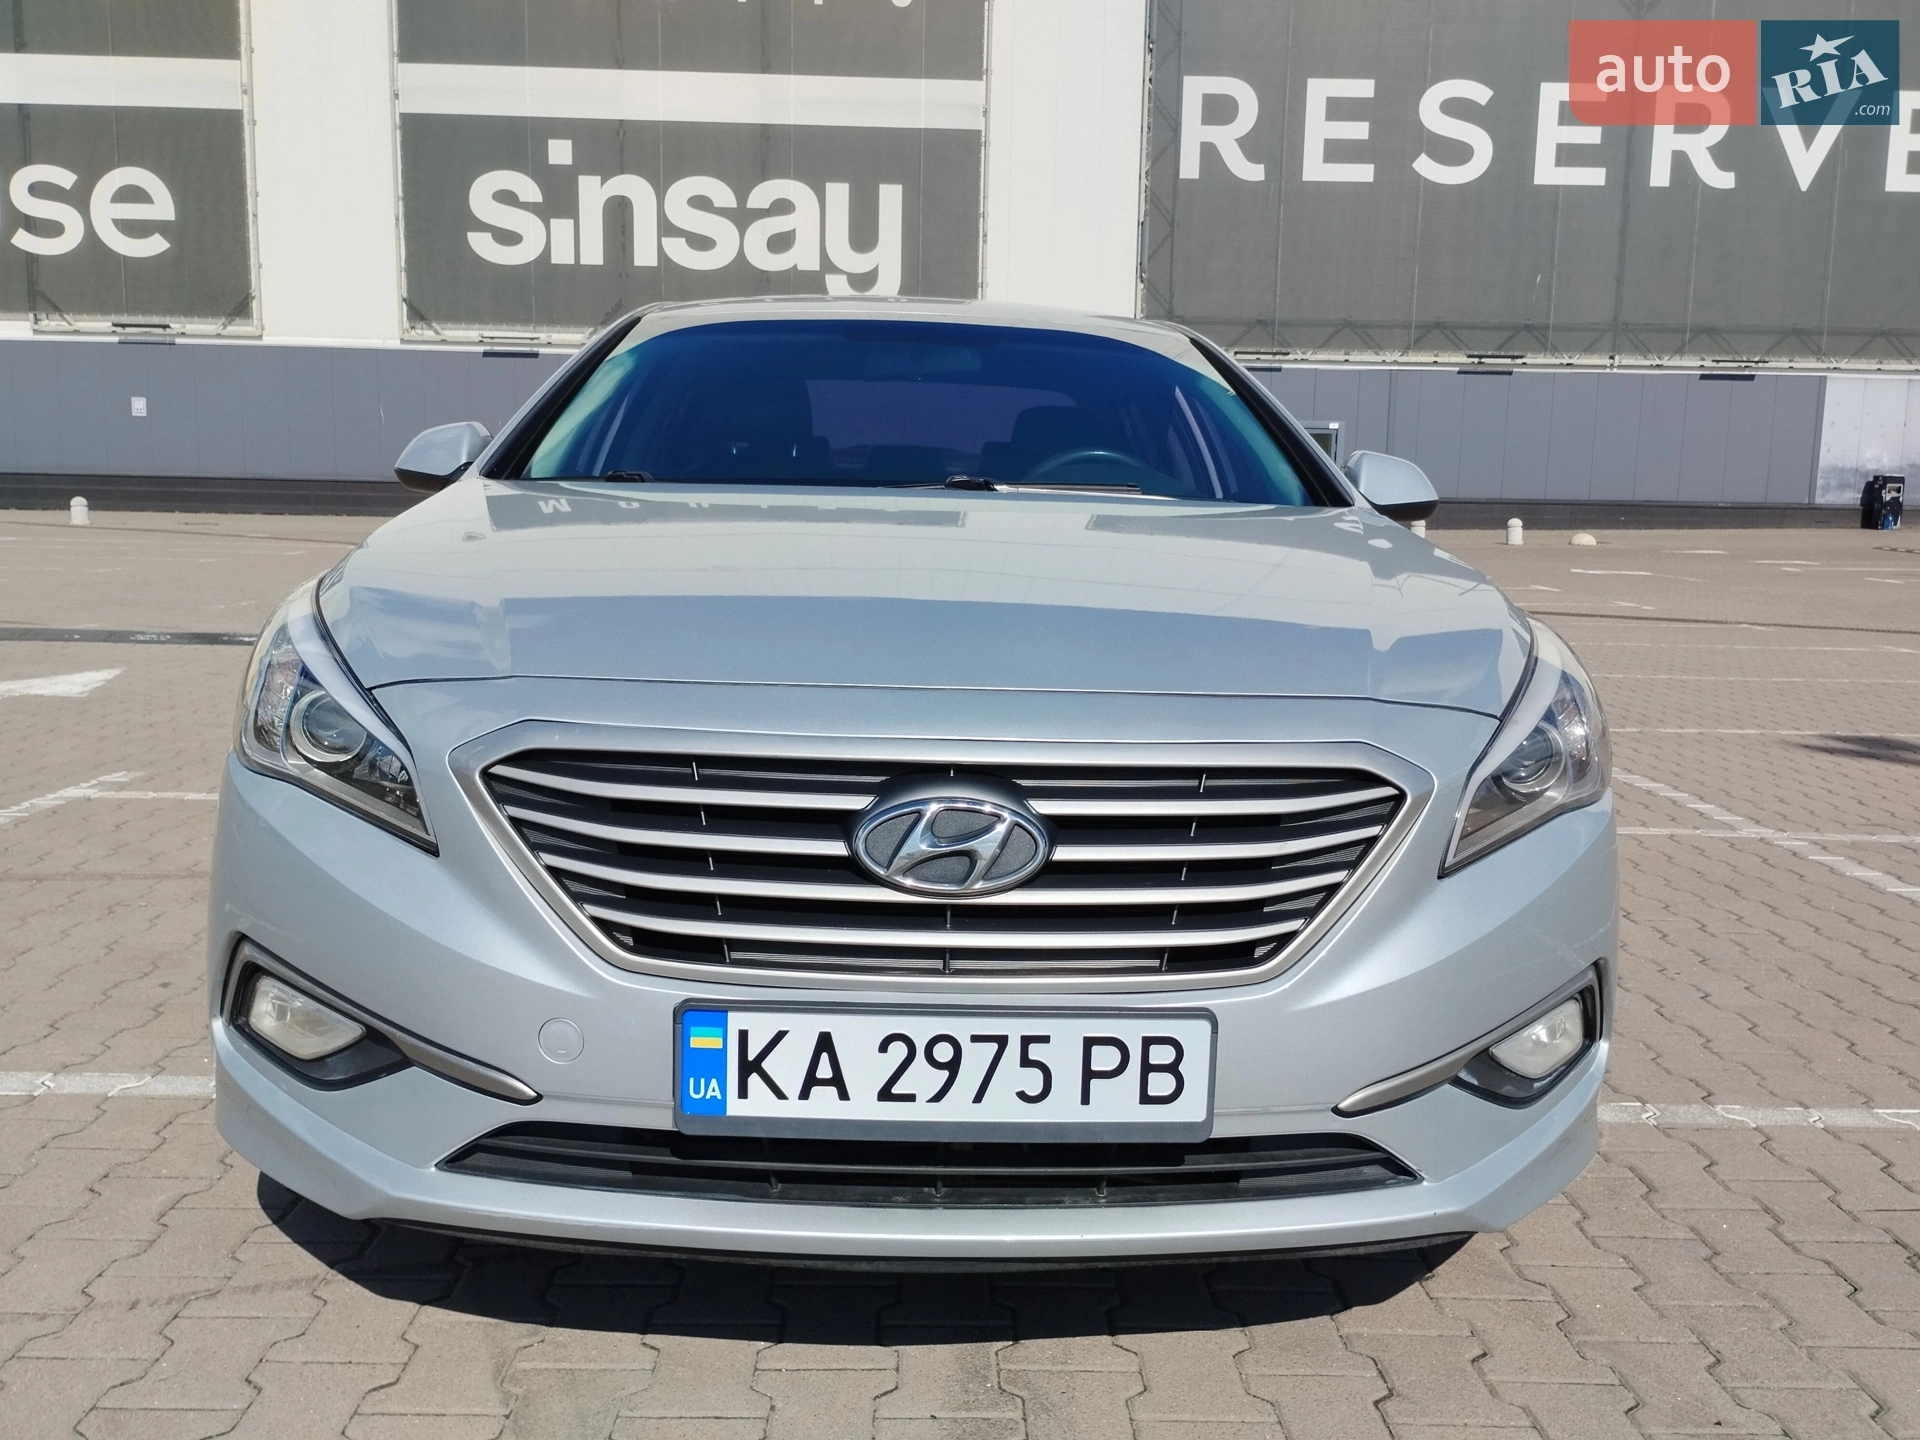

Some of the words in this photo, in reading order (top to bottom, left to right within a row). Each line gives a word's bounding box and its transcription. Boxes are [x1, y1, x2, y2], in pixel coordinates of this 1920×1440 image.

[9, 164, 175, 258] se
[467, 139, 903, 296] sinsay
[689, 1077, 722, 1100] UA
[737, 1029, 851, 1101] KA
[876, 1032, 1053, 1105] 2975
[1080, 1035, 1186, 1106] PB
